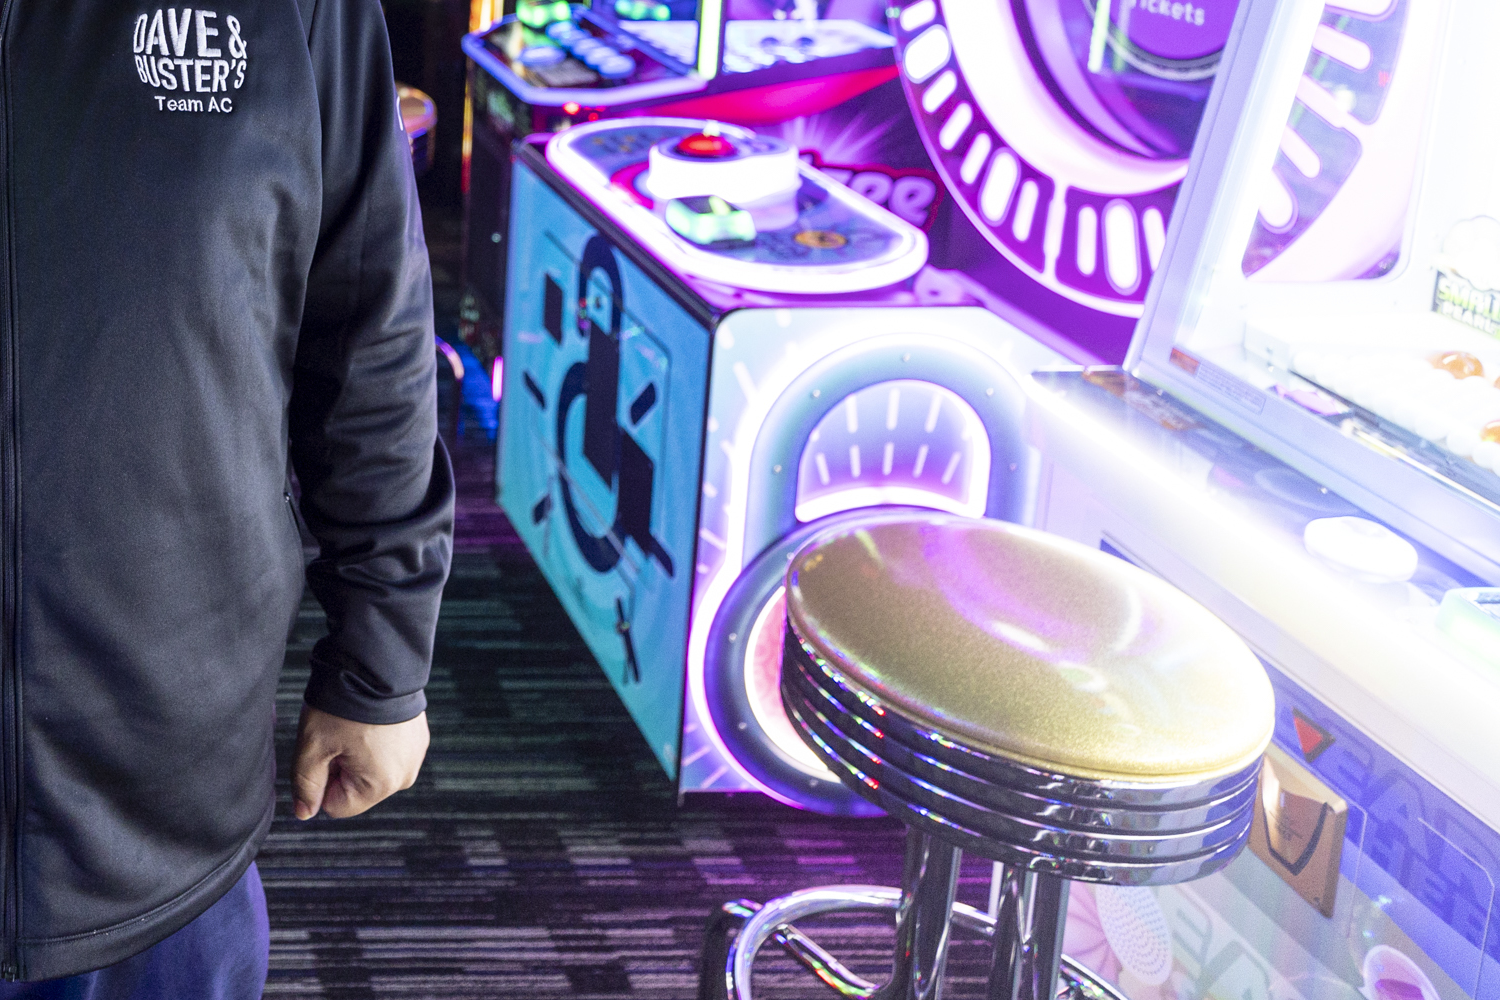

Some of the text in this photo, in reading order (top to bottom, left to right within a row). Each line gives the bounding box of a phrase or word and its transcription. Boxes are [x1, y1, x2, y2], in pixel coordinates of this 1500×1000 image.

[133, 8, 248, 60] DAVE &
[134, 54, 247, 93] BUSTER'S
[154, 95, 233, 114] Team AC
